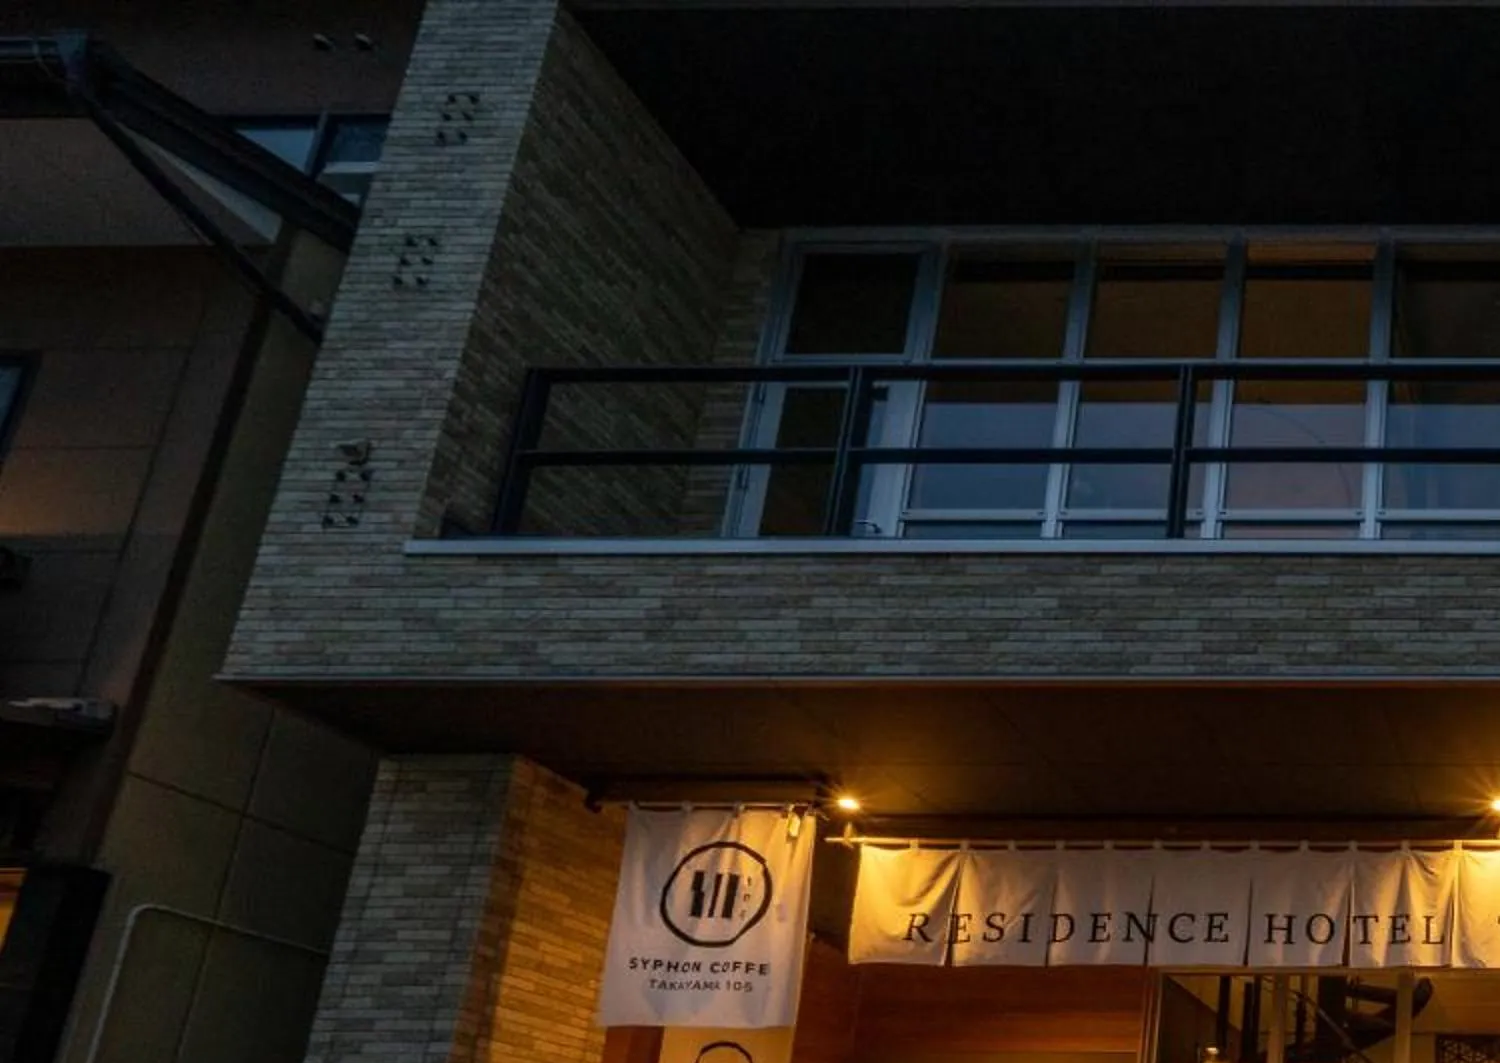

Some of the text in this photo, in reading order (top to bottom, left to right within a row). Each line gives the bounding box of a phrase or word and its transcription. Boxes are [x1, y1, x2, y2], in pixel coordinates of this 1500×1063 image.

[903, 912, 1230, 943] RESIDENCE
[1263, 913, 1445, 945] HOTEL
[628, 957, 702, 974] SYPHON
